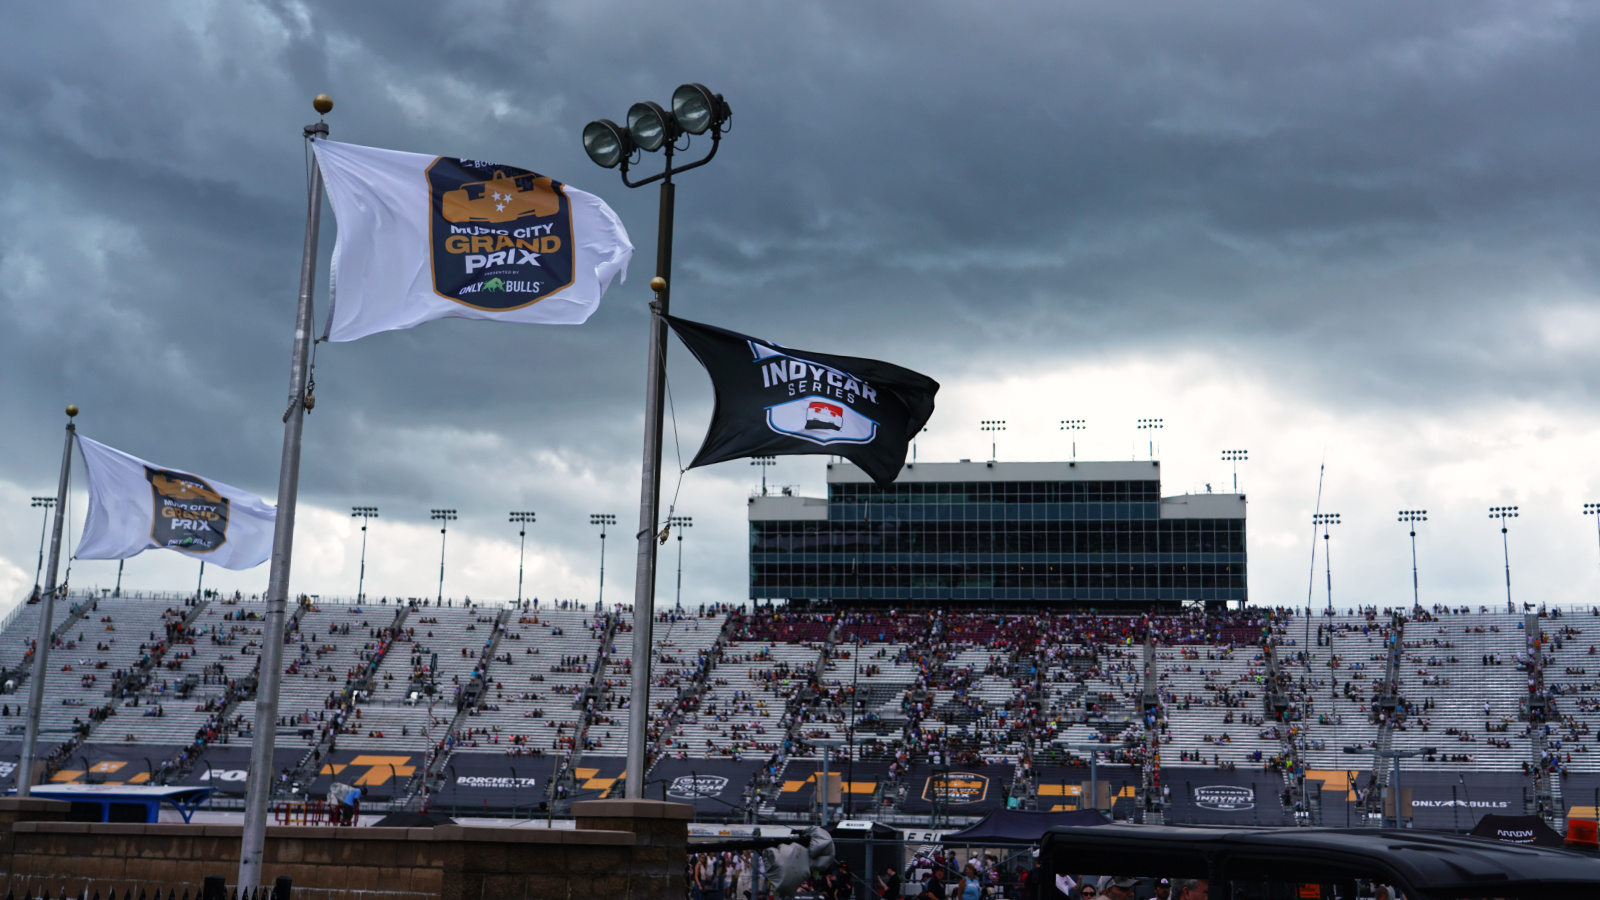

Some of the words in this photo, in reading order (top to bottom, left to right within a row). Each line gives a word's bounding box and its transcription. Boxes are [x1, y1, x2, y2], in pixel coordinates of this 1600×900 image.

[450, 223, 509, 236] MUSIC
[513, 222, 554, 239] CITY
[445, 235, 562, 254] GRAND
[465, 248, 541, 275] PRIX
[458, 281, 484, 295] ONLY
[505, 280, 540, 293] BULLS
[761, 359, 878, 404] INDYCAR
[788, 380, 855, 404] SERIES
[190, 504, 217, 512] CITY
[171, 518, 211, 531] PRIX
[199, 769, 248, 782] FO
[456, 776, 536, 786] BORCHETTA
